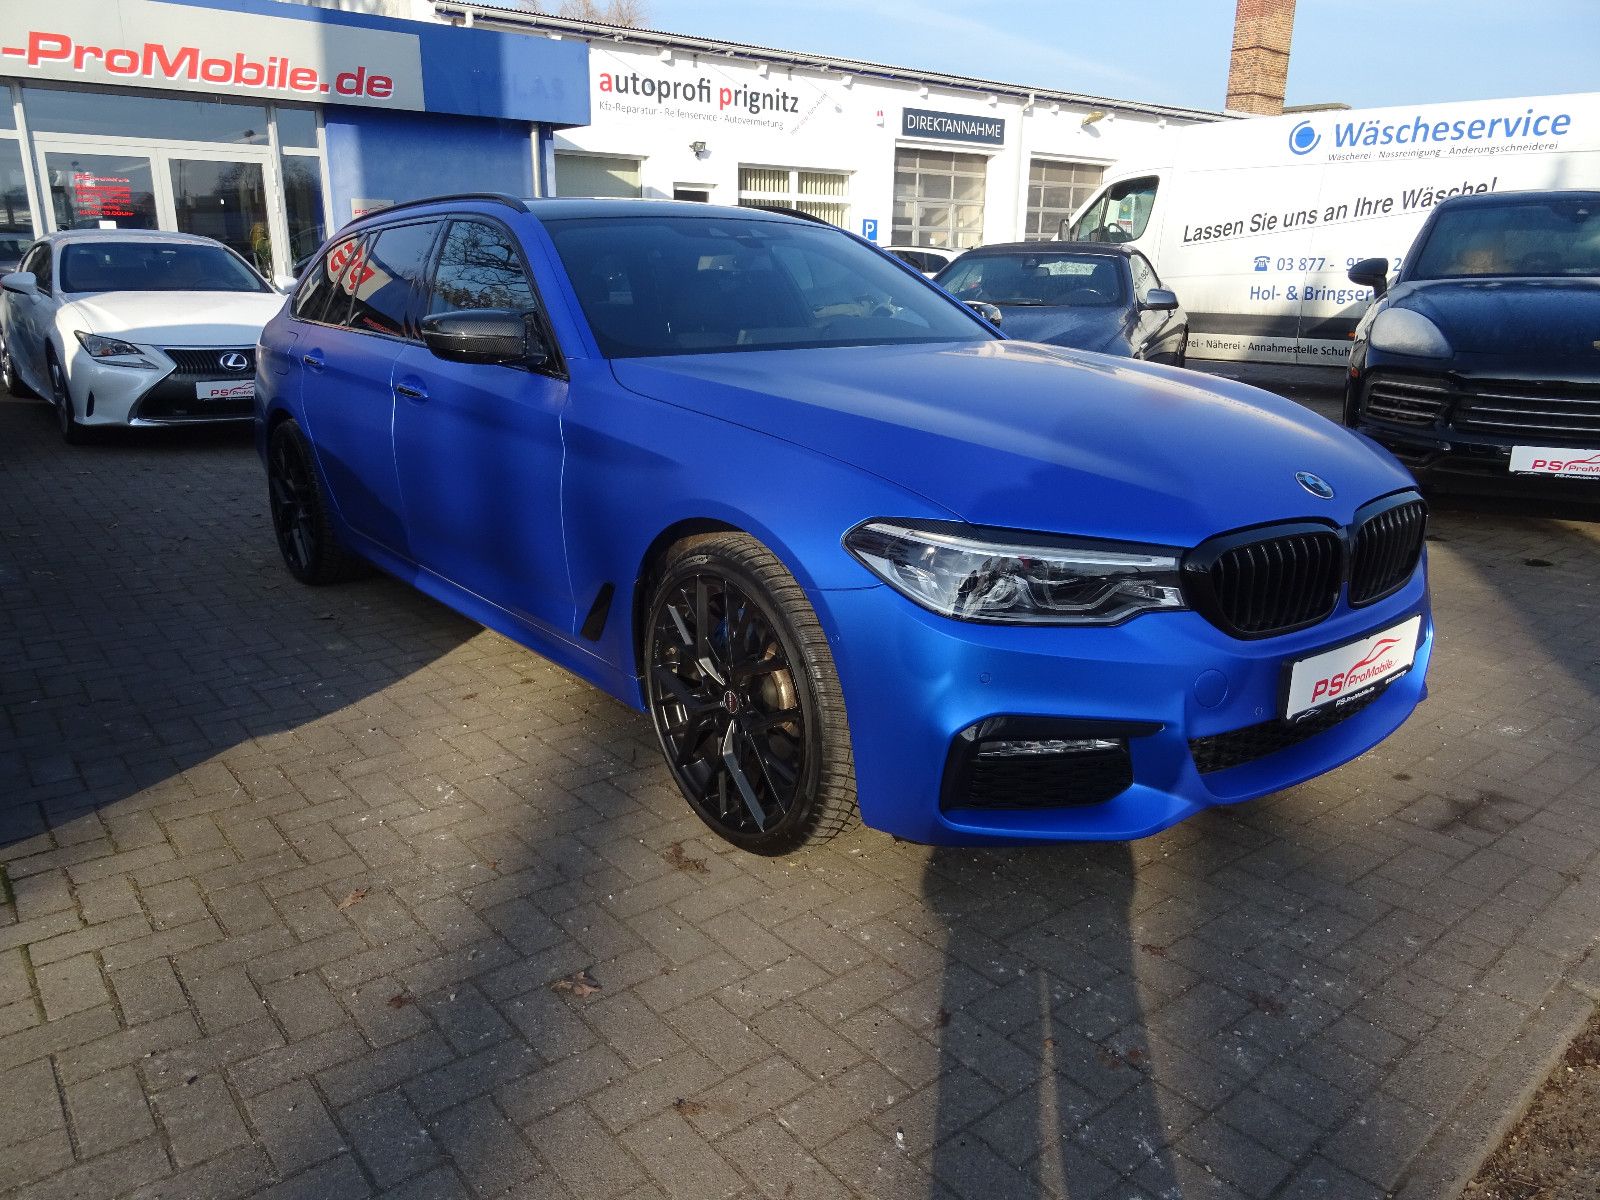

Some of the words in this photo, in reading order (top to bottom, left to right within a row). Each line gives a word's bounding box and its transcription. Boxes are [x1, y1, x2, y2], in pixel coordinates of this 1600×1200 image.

[599, 72, 711, 104] autoprofi
[719, 83, 799, 114] prignitz
[599, 101, 657, 115] Kfz-Reparatur
[665, 108, 718, 122] Reifenservice
[724, 114, 785, 131] Autovermietung
[907, 114, 1001, 138] DIREKTANNAHME
[1335, 108, 1572, 148] Wäscheservice
[1378, 149, 1441, 161] Nassreinigung
[1449, 142, 1559, 156] Änderungsschneiderei
[1183, 218, 1244, 243] Lassen
[1249, 213, 1277, 233] Sie
[1283, 208, 1317, 228] uns
[1323, 203, 1347, 223] an
[1353, 196, 1394, 218] Ihre
[1402, 176, 1498, 210] Wäsche!
[865, 221, 875, 239] P
[1276, 257, 1294, 271] 03
[1298, 257, 1326, 271] 877
[1250, 284, 1281, 301] Hol-
[1286, 285, 1299, 301] &
[1206, 339, 1241, 350] Näherei
[1247, 341, 1319, 355] Annahmestelle
[1320, 346, 1351, 357] Schuh
[1531, 459, 1564, 471] PS
[1310, 672, 1345, 703] PS
[1347, 659, 1393, 687] ProMobile
